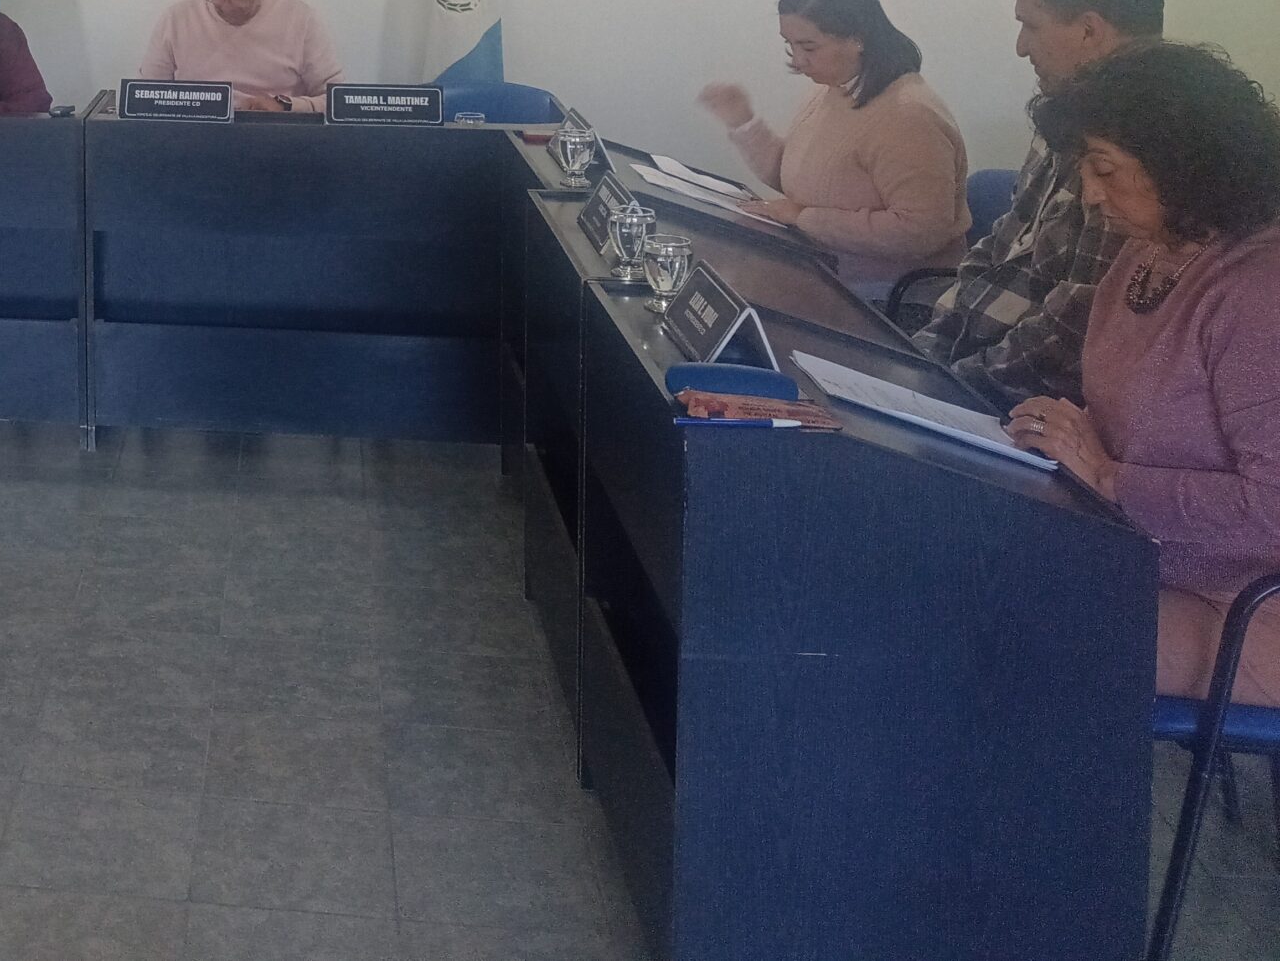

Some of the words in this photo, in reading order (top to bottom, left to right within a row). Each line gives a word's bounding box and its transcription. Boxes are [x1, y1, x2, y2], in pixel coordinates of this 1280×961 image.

[134, 89, 178, 100] SEBASTIÁN
[179, 90, 222, 101] RAIMONDO
[344, 95, 378, 104] TAMARA
[379, 96, 387, 105] L.
[387, 96, 430, 106] MARTINEZ
